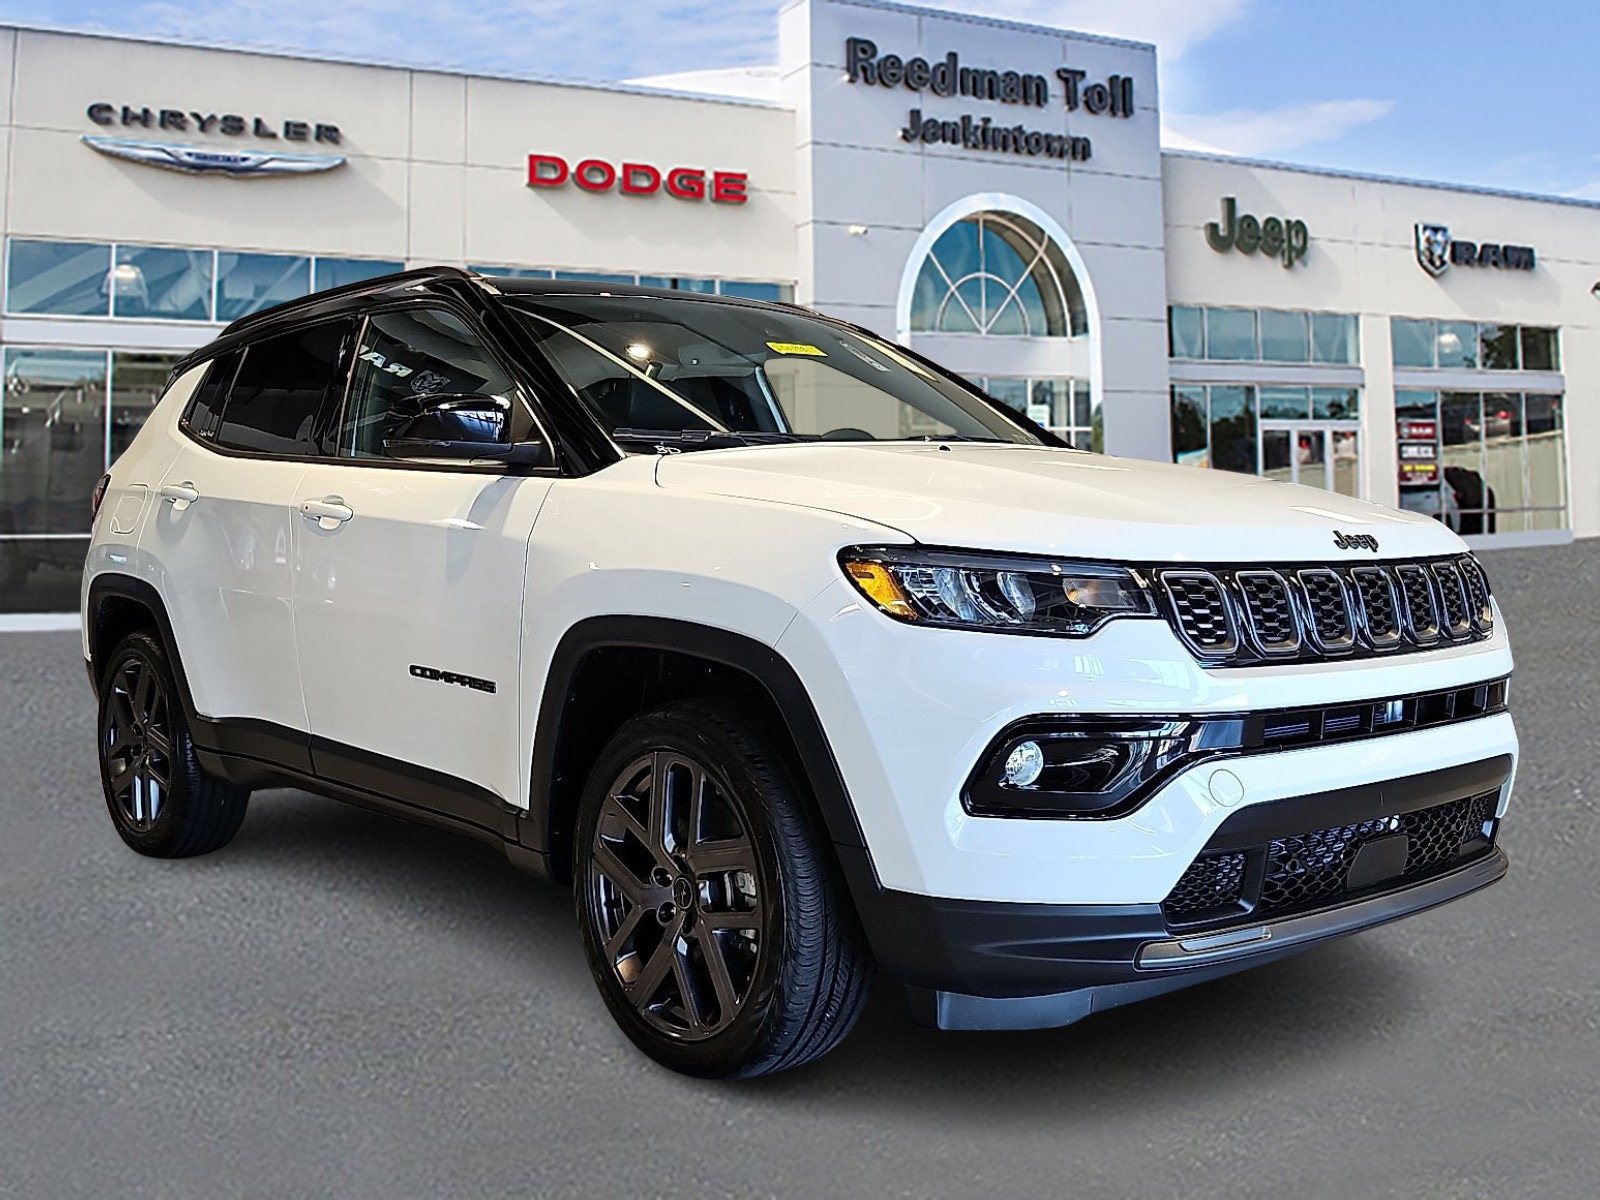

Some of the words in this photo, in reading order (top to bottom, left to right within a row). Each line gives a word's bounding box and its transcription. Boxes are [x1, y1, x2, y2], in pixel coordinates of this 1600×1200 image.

[846, 37, 1049, 107] Reedman
[1056, 67, 1134, 118] Toll
[87, 102, 342, 144] CHRYSLER
[901, 109, 1091, 161] Jenkintown
[527, 153, 749, 204] DODGE
[1204, 196, 1309, 270] Jeep
[1450, 240, 1535, 271] RAM
[1332, 530, 1379, 553] Jeep
[409, 664, 496, 694] COMPASS
